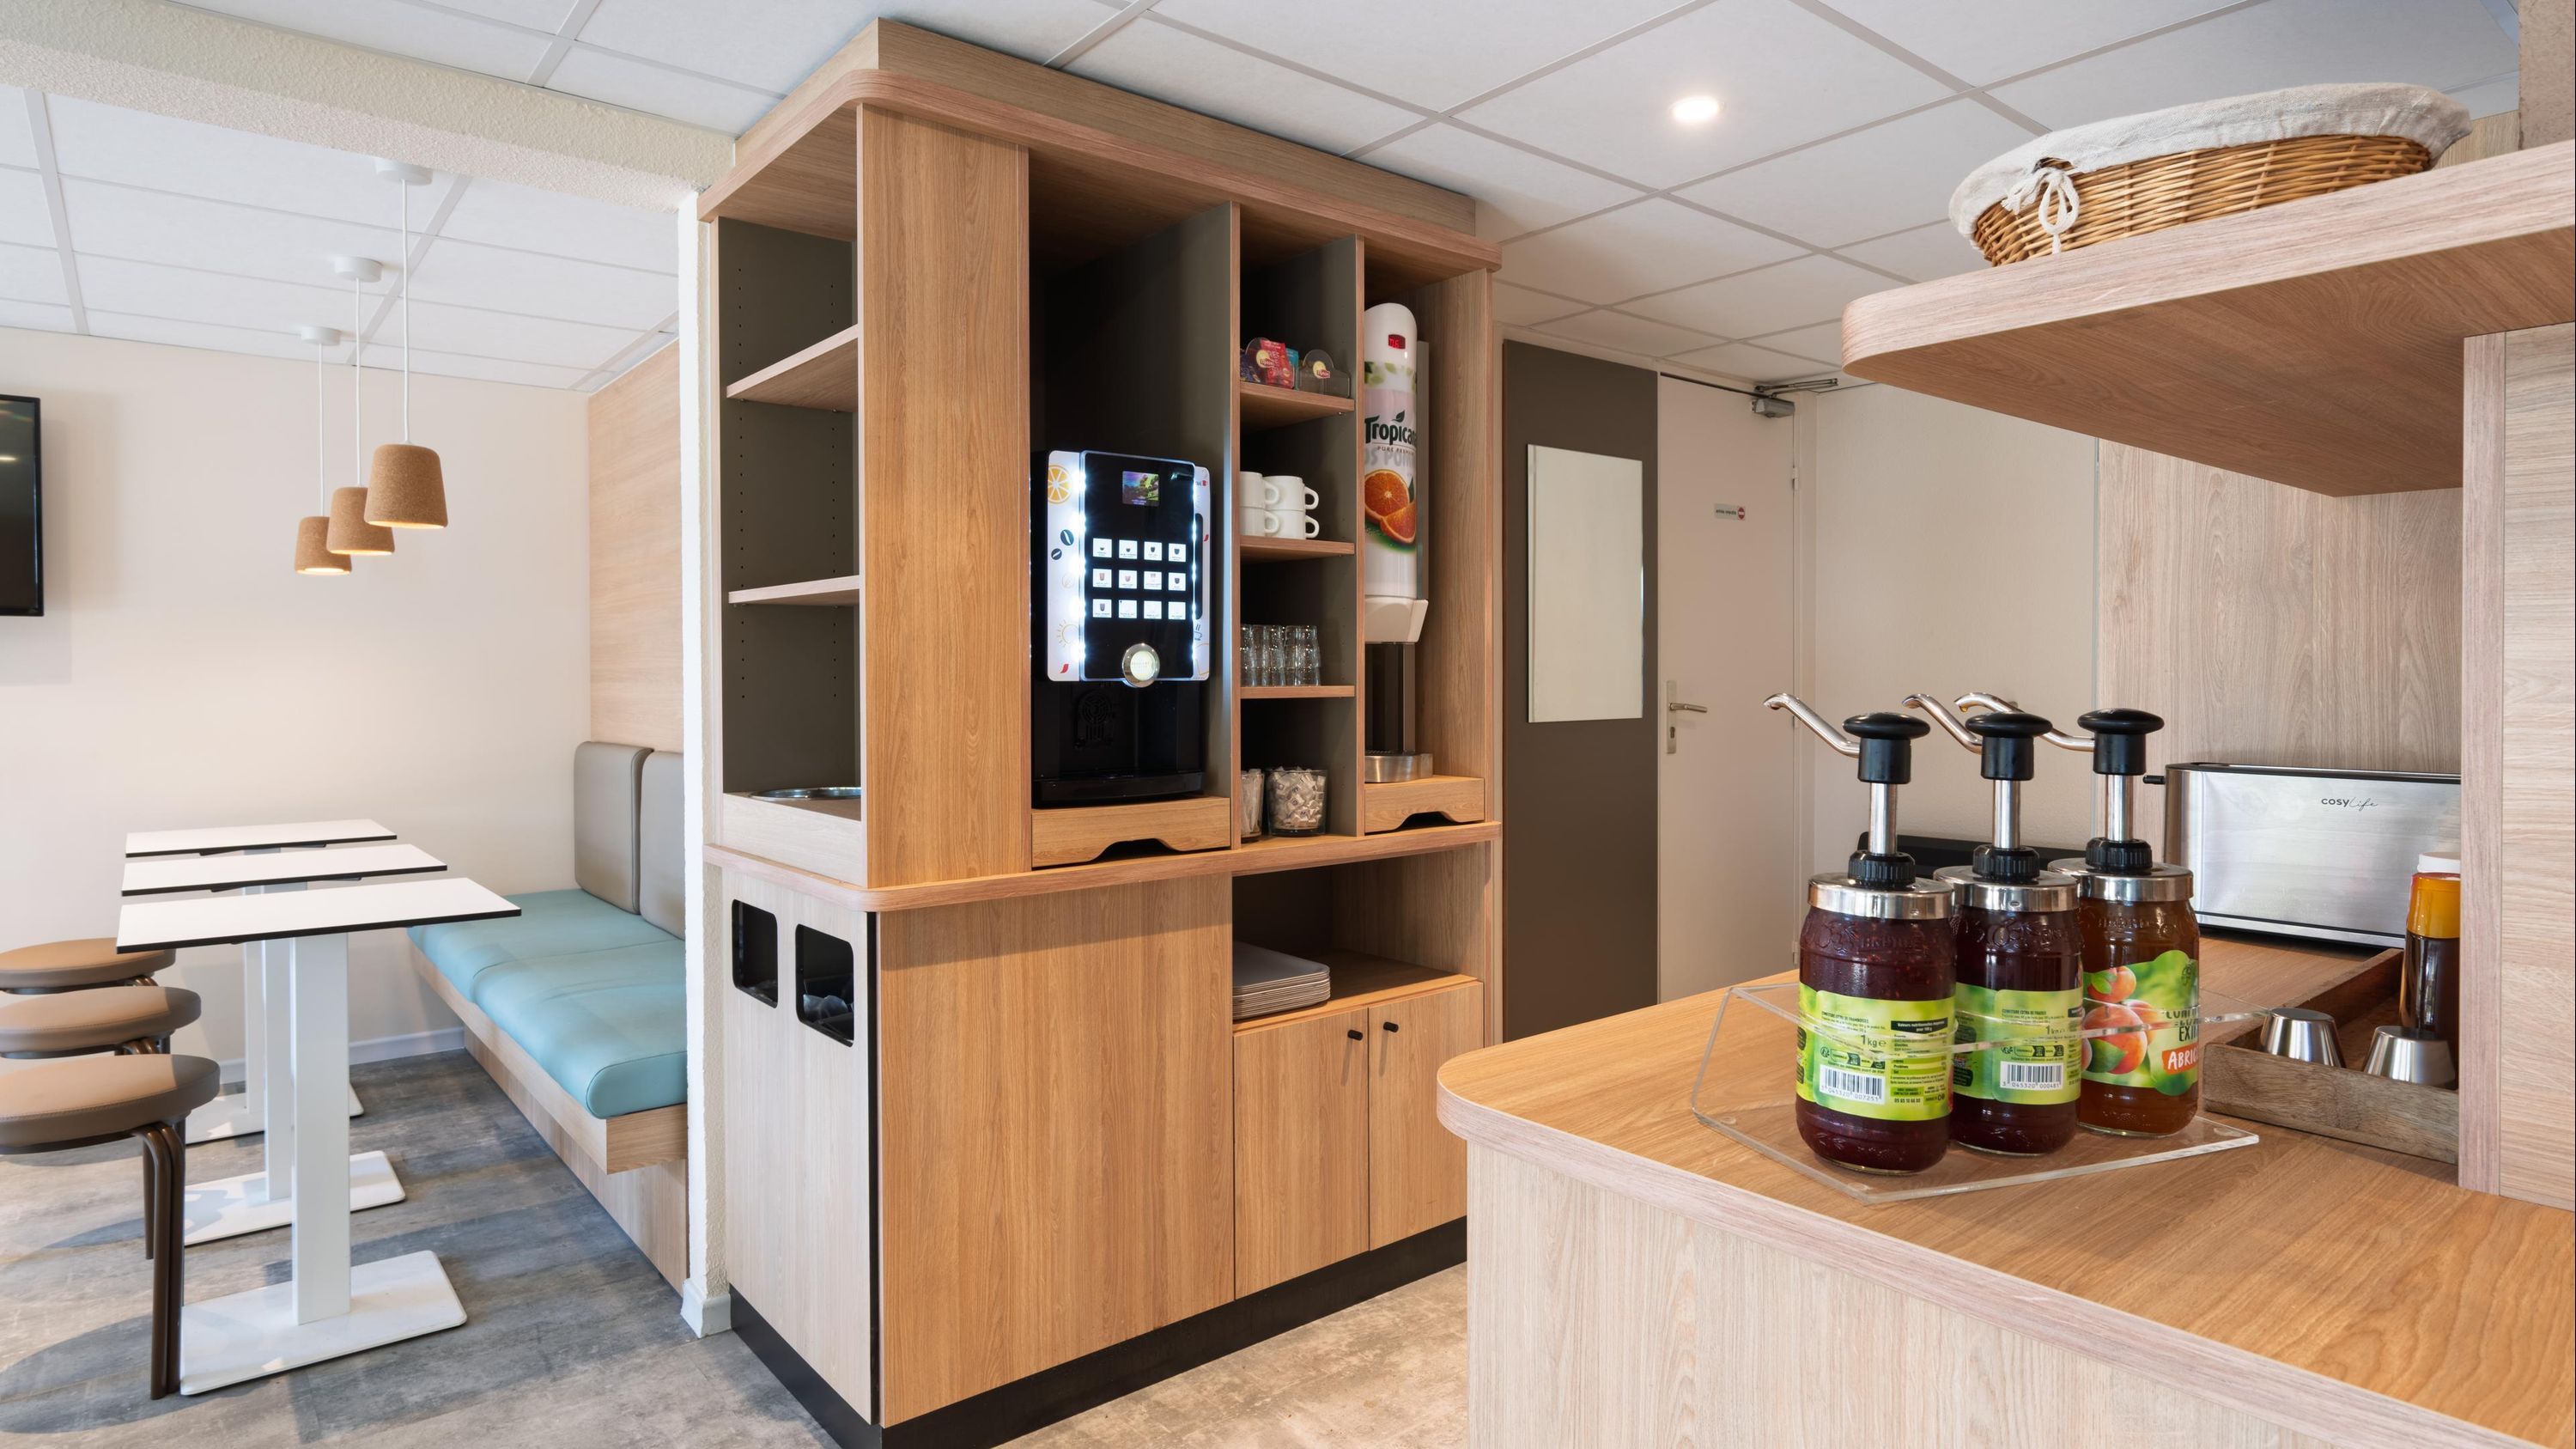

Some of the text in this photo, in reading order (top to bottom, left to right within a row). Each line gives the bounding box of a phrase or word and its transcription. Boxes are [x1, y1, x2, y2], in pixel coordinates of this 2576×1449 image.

[1364, 415, 1417, 446] Tropican
[2045, 1025, 2050, 1035] 1
[1861, 1034, 1866, 1044] 1
[1868, 1038, 1877, 1048] kg
[2167, 1047, 2198, 1070] ABRIC
[1827, 1087, 1850, 1097] 045320
